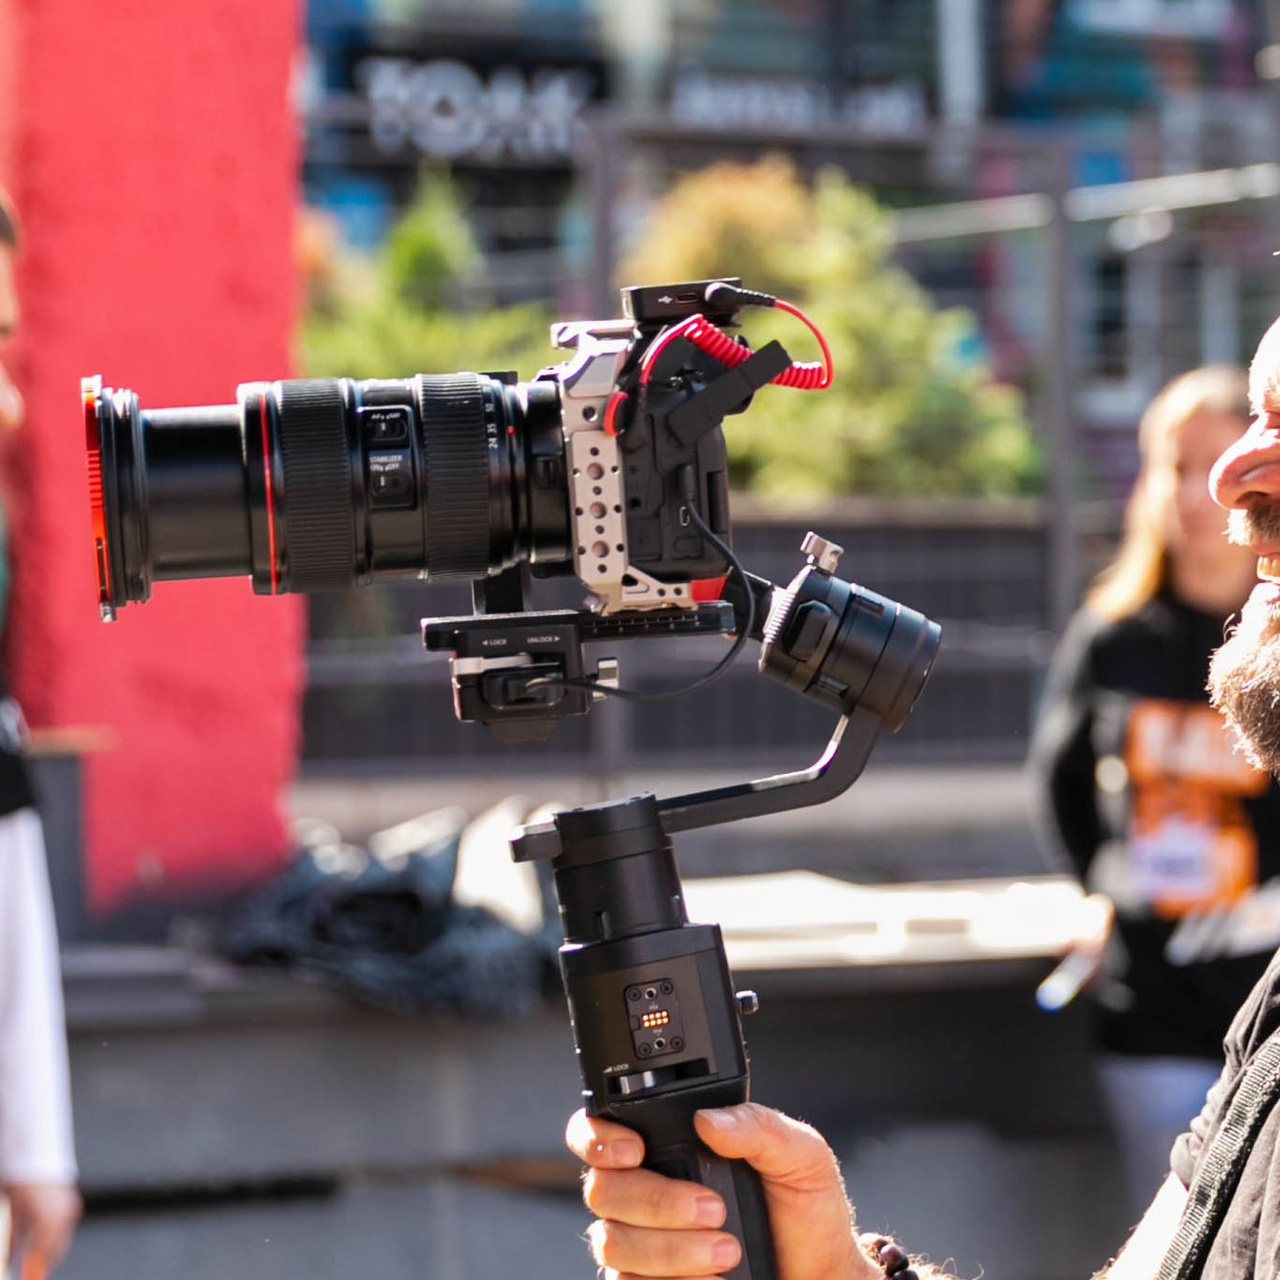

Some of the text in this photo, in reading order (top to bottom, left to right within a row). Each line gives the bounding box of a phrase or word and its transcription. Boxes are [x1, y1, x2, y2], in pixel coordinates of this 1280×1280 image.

[369, 454, 402, 463] STABILIZER
[489, 636, 554, 646] LOCK UNLOCK
[613, 1063, 629, 1072] LOCK
